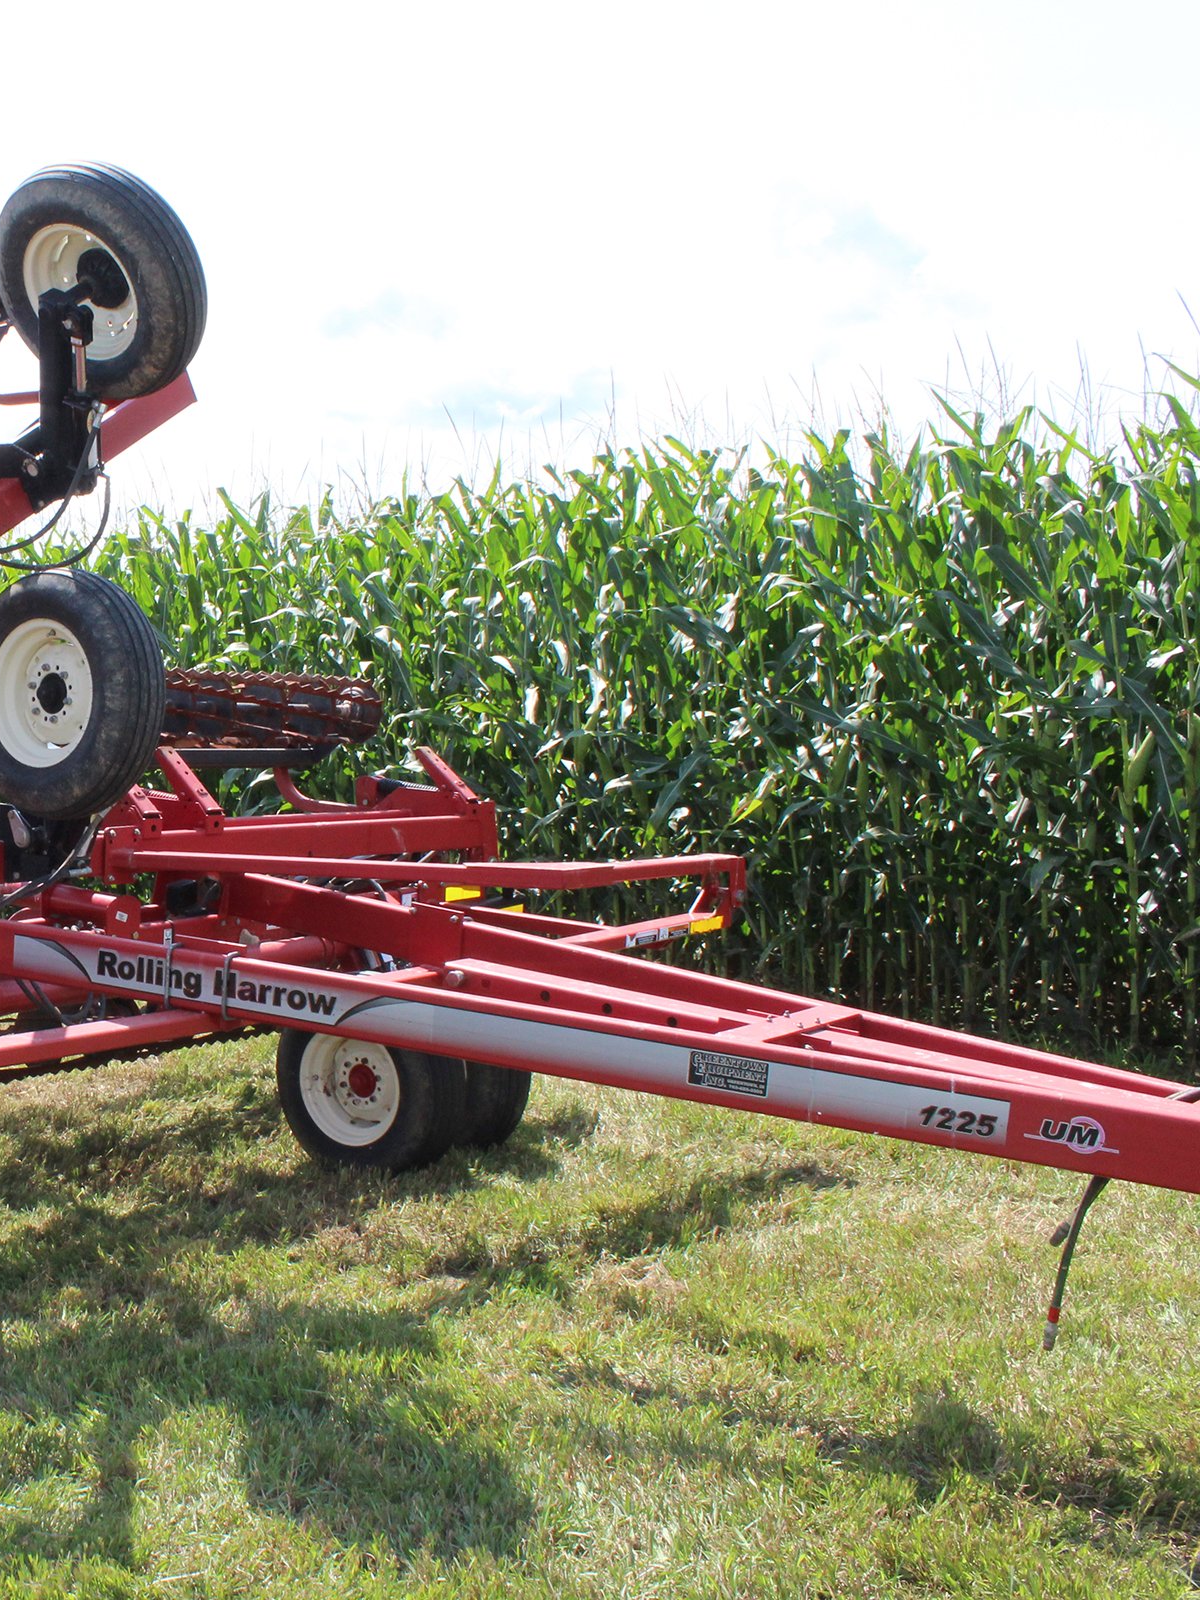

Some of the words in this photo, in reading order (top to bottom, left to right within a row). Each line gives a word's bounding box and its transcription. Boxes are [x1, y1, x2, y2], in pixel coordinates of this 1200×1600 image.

[97, 950, 201, 998] Rolling
[213, 969, 337, 1016] Harrow
[692, 1052, 767, 1072] GREENTOWN
[695, 1062, 766, 1082] EQUIPMENT
[701, 1073, 727, 1088] INC.
[920, 1105, 998, 1137] 1225
[1040, 1119, 1101, 1147] UM
